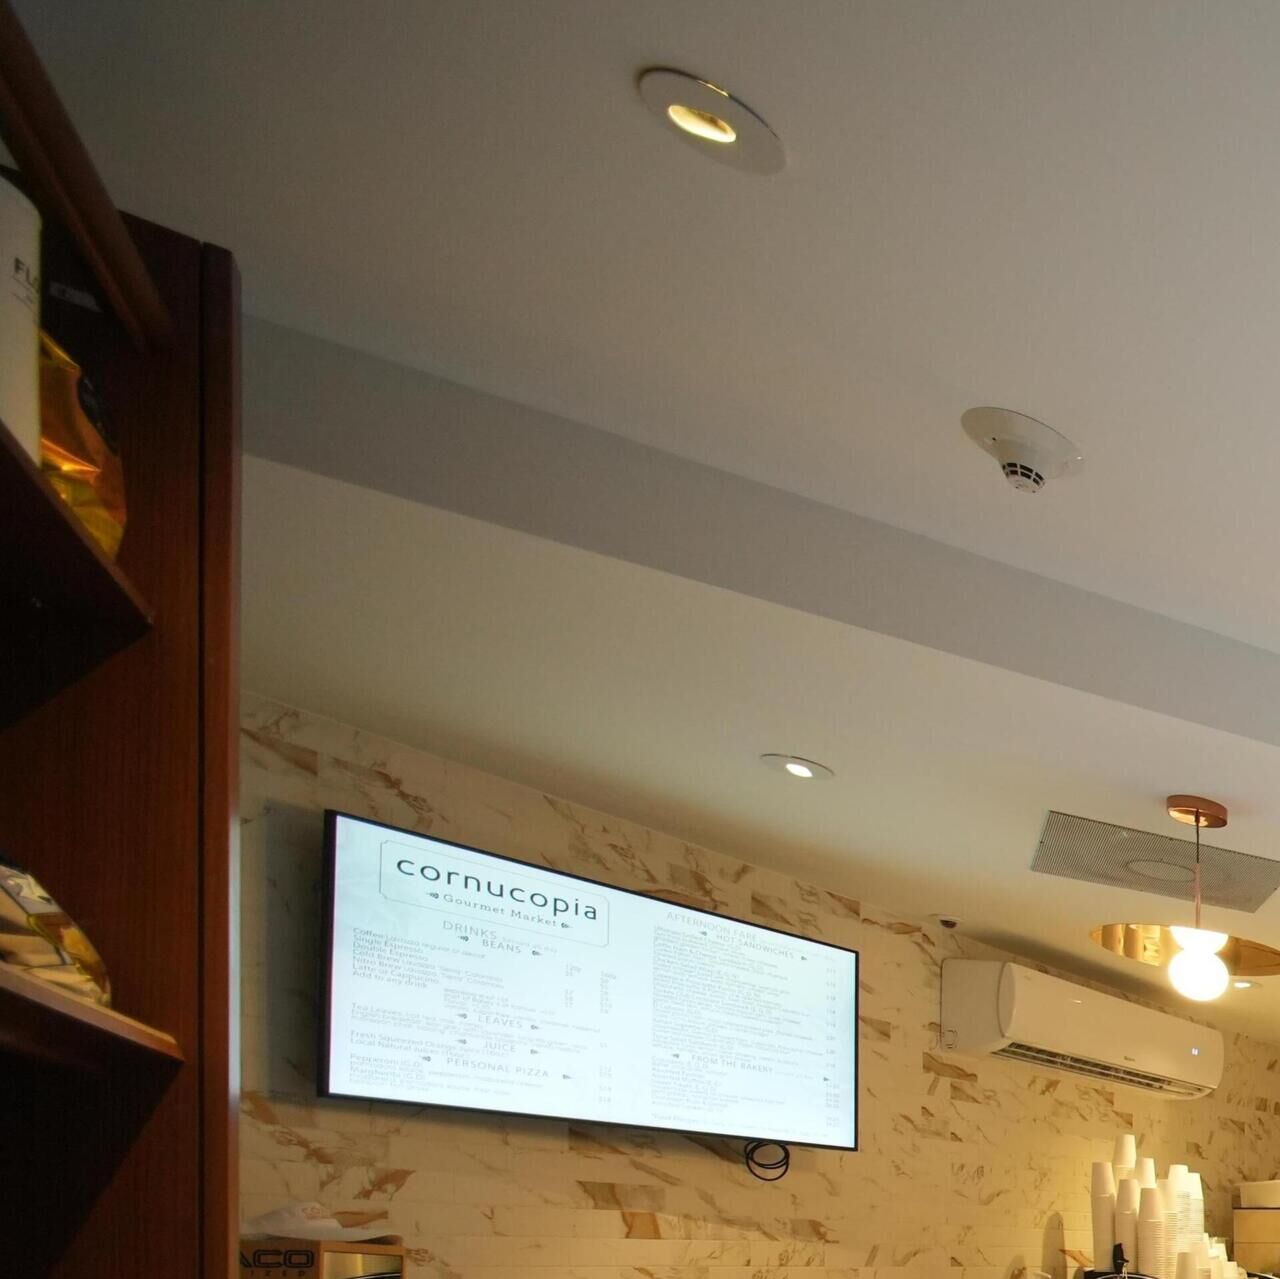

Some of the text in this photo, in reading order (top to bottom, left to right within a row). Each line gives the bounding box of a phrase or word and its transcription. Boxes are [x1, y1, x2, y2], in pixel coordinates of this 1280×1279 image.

[397, 860, 597, 920] cornucopia
[443, 893, 557, 928] Gourmet Market
[443, 920, 497, 940] DRINKS
[482, 938, 522, 954] BEANS
[716, 933, 795, 959] HOT SANDWICHES
[478, 1015, 523, 1029] LEAVES
[485, 1040, 517, 1053] JUICE
[447, 1057, 549, 1078] PERSONAL PIZZA
